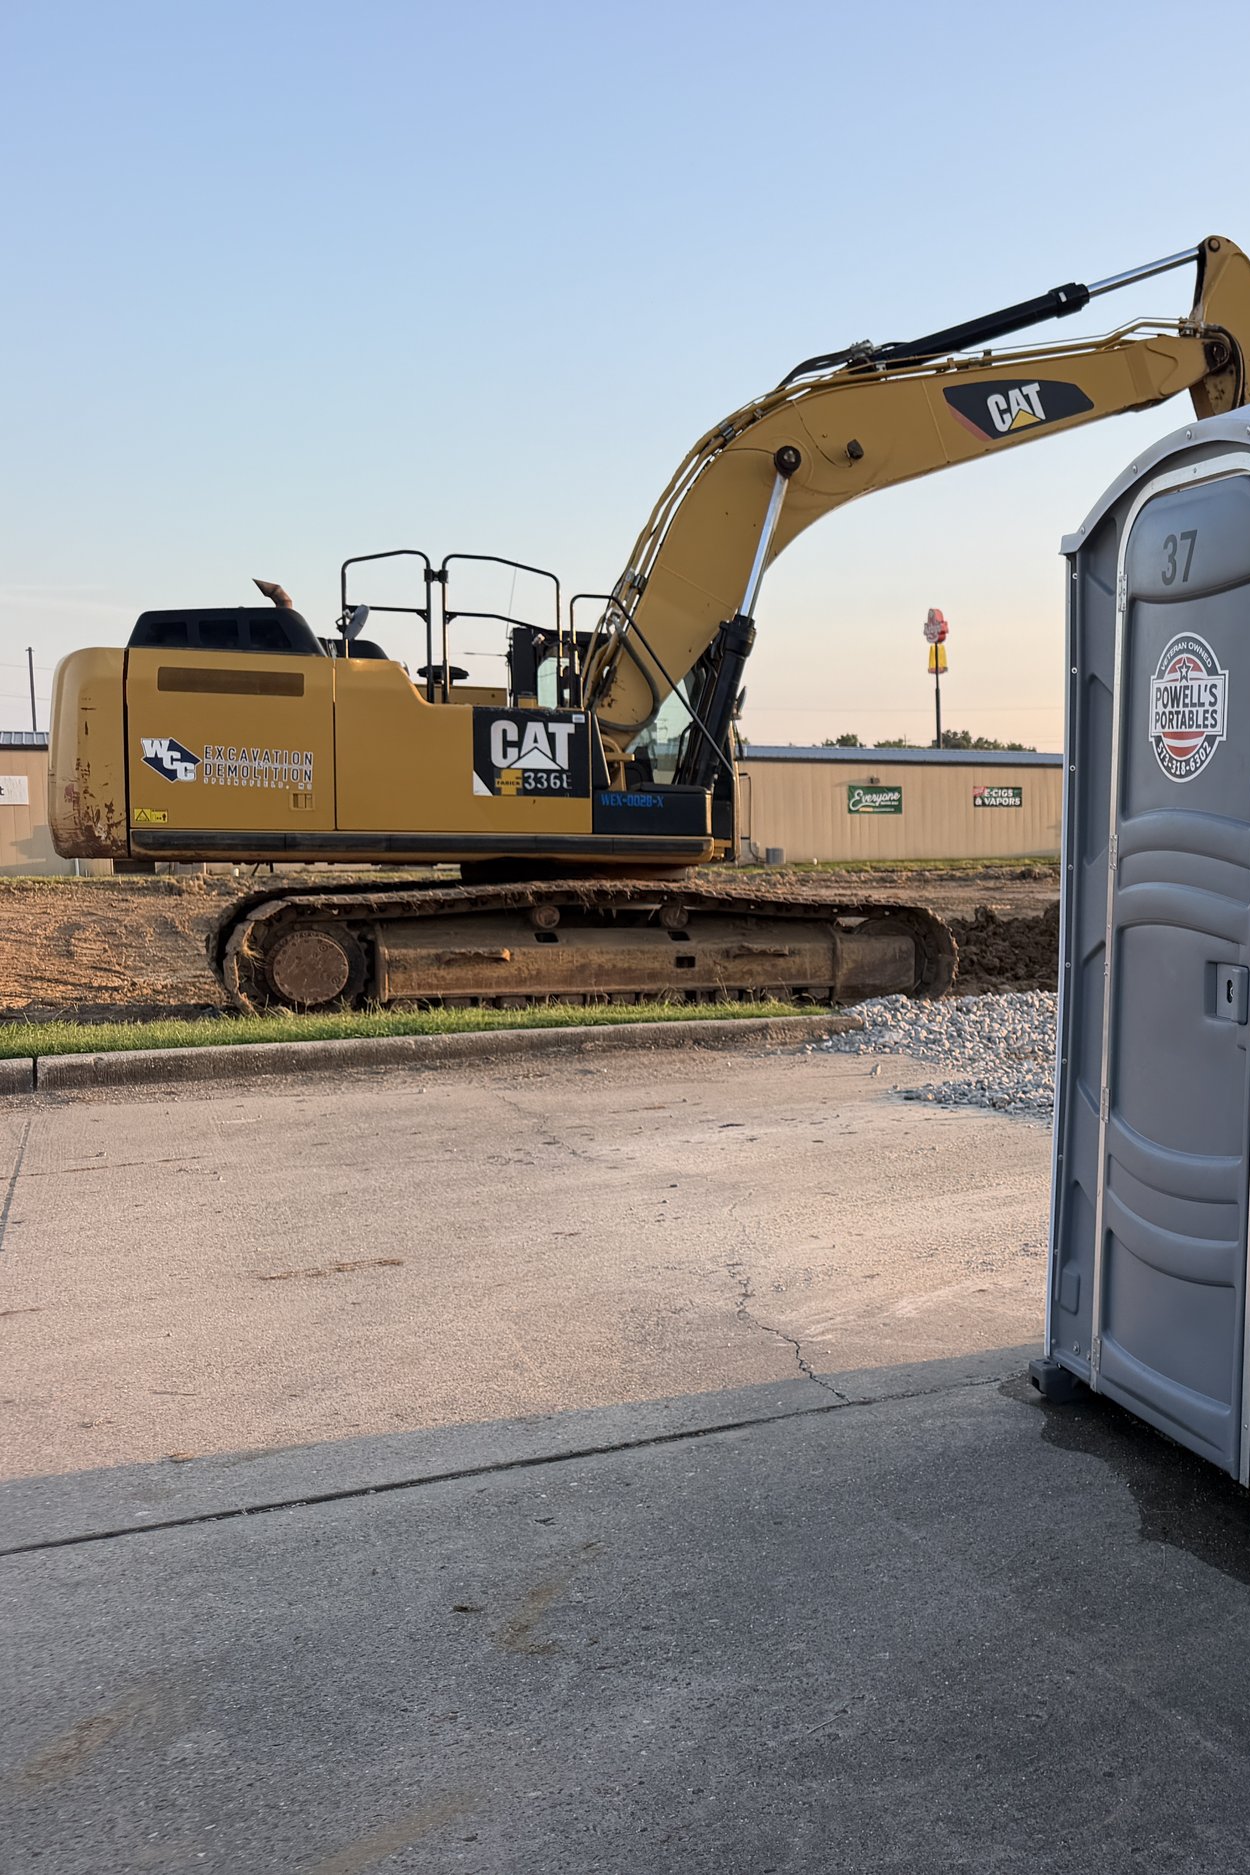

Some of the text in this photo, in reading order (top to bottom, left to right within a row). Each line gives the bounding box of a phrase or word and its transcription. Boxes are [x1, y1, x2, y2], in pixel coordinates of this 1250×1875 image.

[987, 382, 1046, 432] CAT
[1161, 529, 1198, 586] 37
[1160, 641, 1212, 670] VETERAN OWNED
[1155, 683, 1218, 709] POWELL'S
[1154, 709, 1218, 730] PORTABLES
[203, 745, 313, 766] EXCAVATION
[490, 719, 576, 770] CAT
[1157, 740, 1211, 776] 573-318-6302
[203, 763, 313, 782] DEMOLITION
[850, 789, 901, 810] Everyone
[975, 797, 1021, 806] & VAPORS
[984, 788, 1014, 797] E-CIGS
